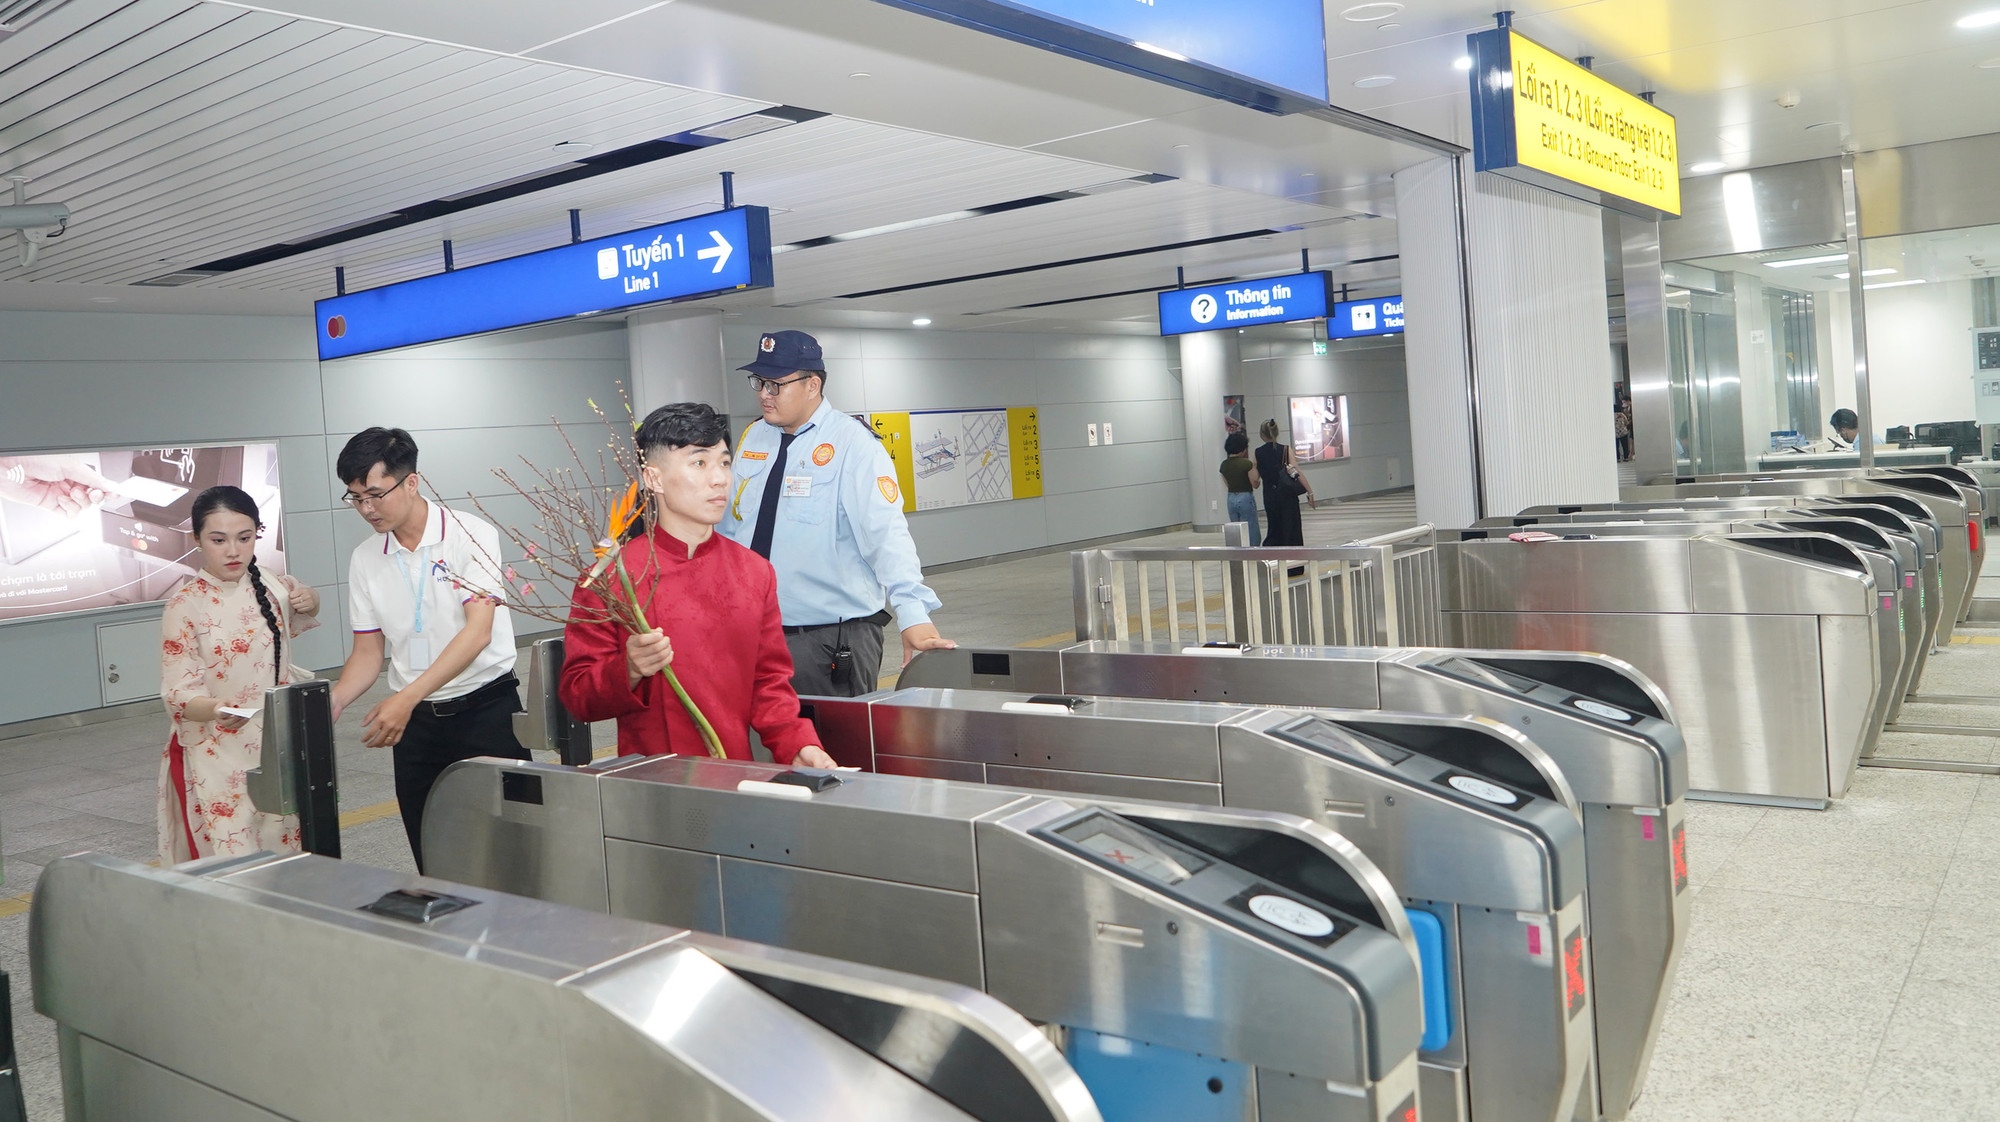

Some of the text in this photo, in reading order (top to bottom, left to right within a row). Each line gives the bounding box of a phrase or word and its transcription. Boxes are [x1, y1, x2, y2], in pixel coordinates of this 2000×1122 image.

[1517, 60, 1538, 103] Lối
[1540, 81, 1553, 110] ra
[1554, 79, 1563, 115] 1,
[1564, 84, 1575, 120] 2,
[1575, 89, 1583, 122] 3
[1584, 94, 1603, 132] (Lối
[1604, 112, 1615, 137] ra
[1541, 122, 1558, 152] Exit
[1576, 137, 1582, 160] 3
[1583, 141, 1613, 173] (Ground
[1614, 152, 1632, 179] Floor
[1633, 159, 1646, 184] Exit
[622, 234, 684, 270] Tuyến 1
[624, 271, 658, 293] Line 1
[1225, 284, 1292, 306] Thông tin
[1226, 304, 1284, 321] Information
[1033, 424, 1037, 435] 2
[1034, 439, 1038, 449] 3
[1035, 454, 1039, 464] 5
[1036, 469, 1040, 479] 6
[1, 575, 33, 586] chạm
[36, 572, 47, 582] là
[68, 569, 97, 579] trạm
[28, 585, 68, 595] Mastercard
